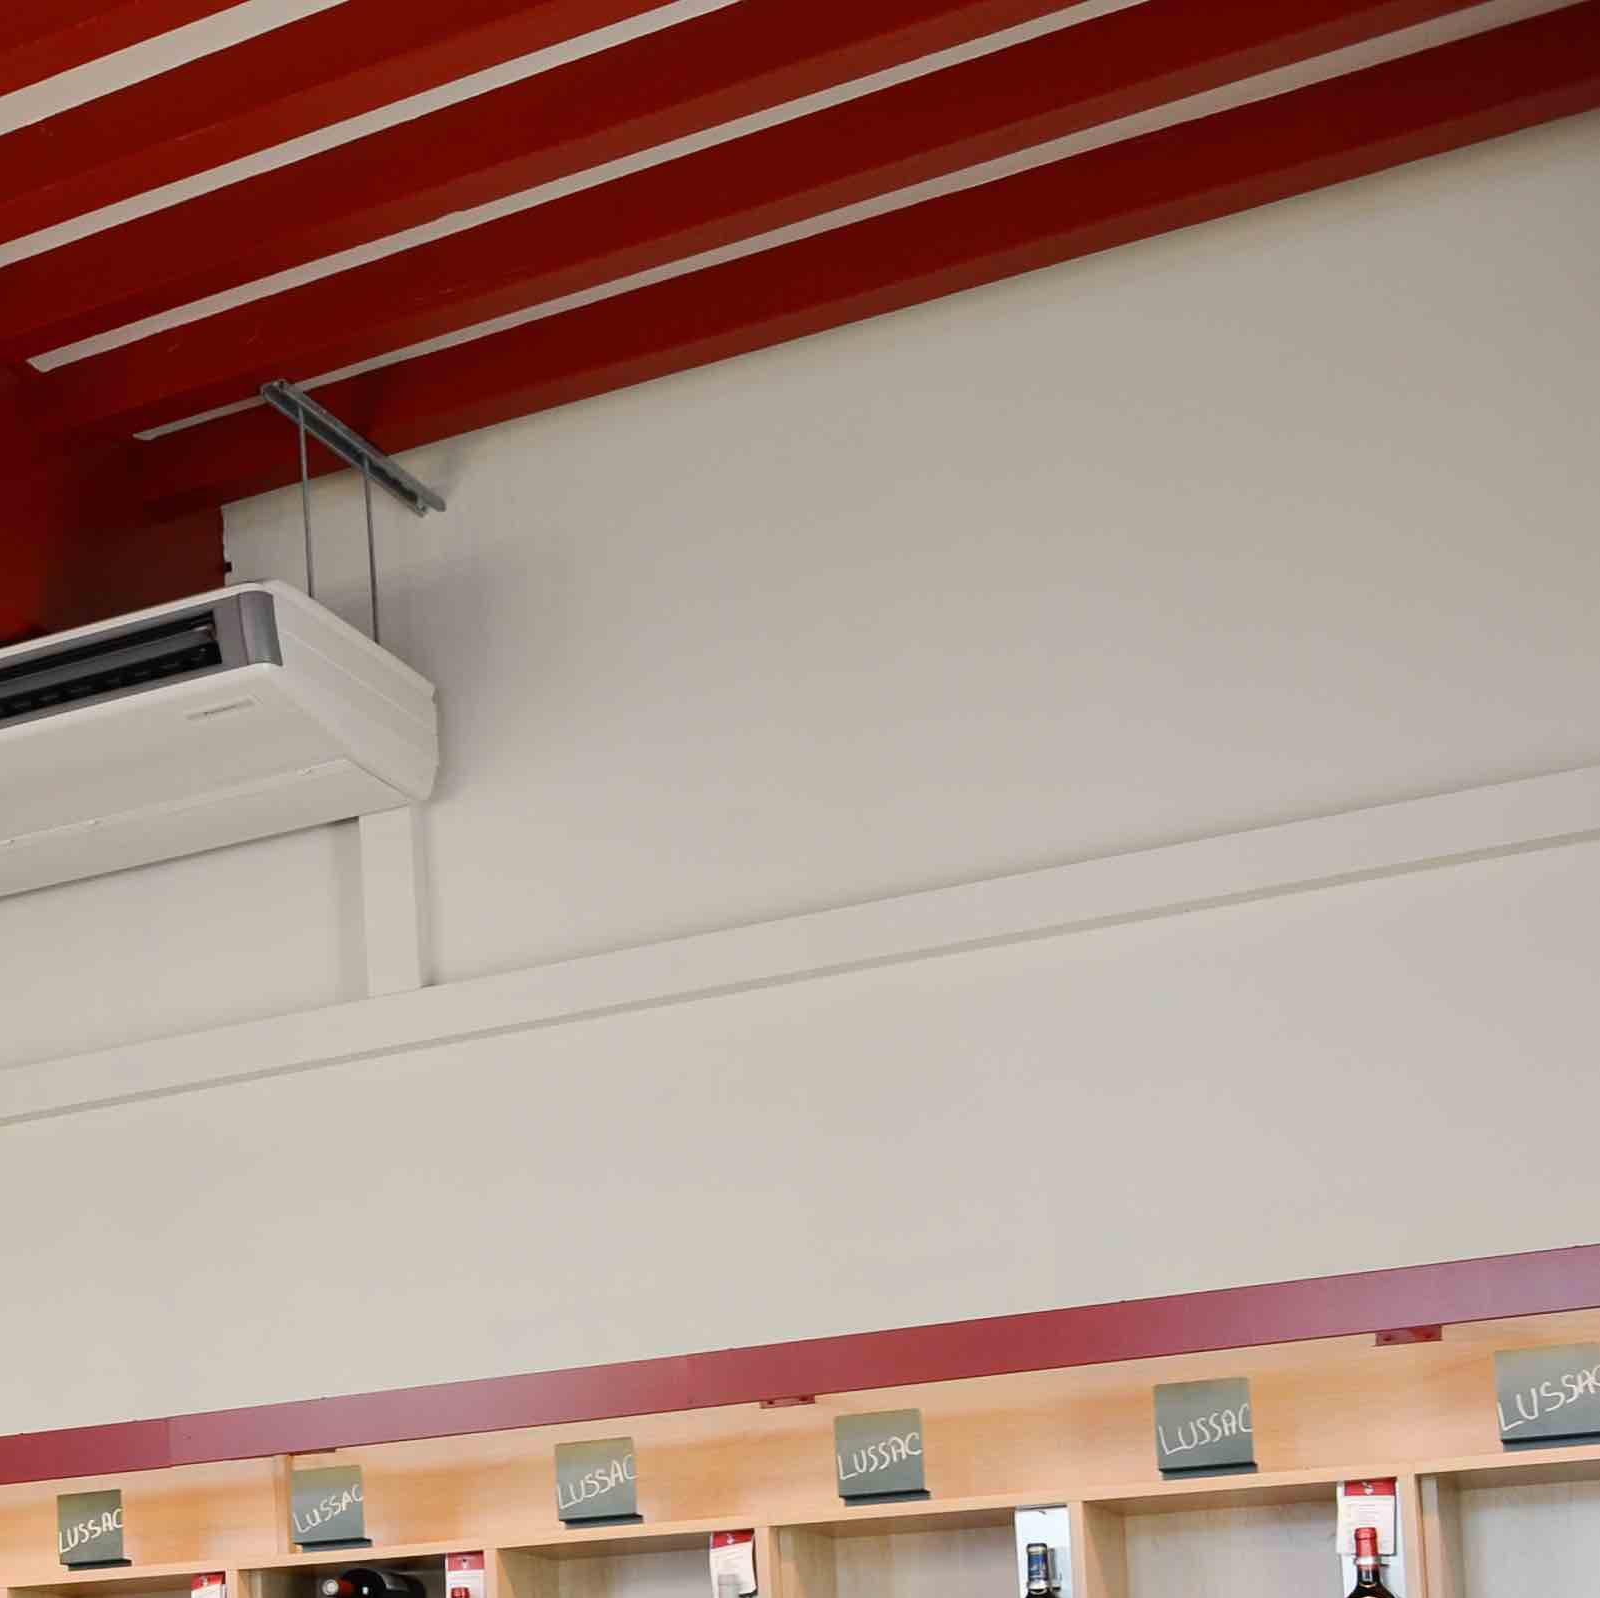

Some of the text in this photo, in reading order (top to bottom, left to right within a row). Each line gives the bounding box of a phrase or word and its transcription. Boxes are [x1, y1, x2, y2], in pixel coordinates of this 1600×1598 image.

[1157, 1402, 1254, 1456] LUSSAC
[836, 1431, 923, 1481] LUSSAC
[555, 1454, 639, 1510] LUSSAC
[57, 1507, 125, 1554] LUSSAC
[292, 1483, 365, 1534] LUSSAC
